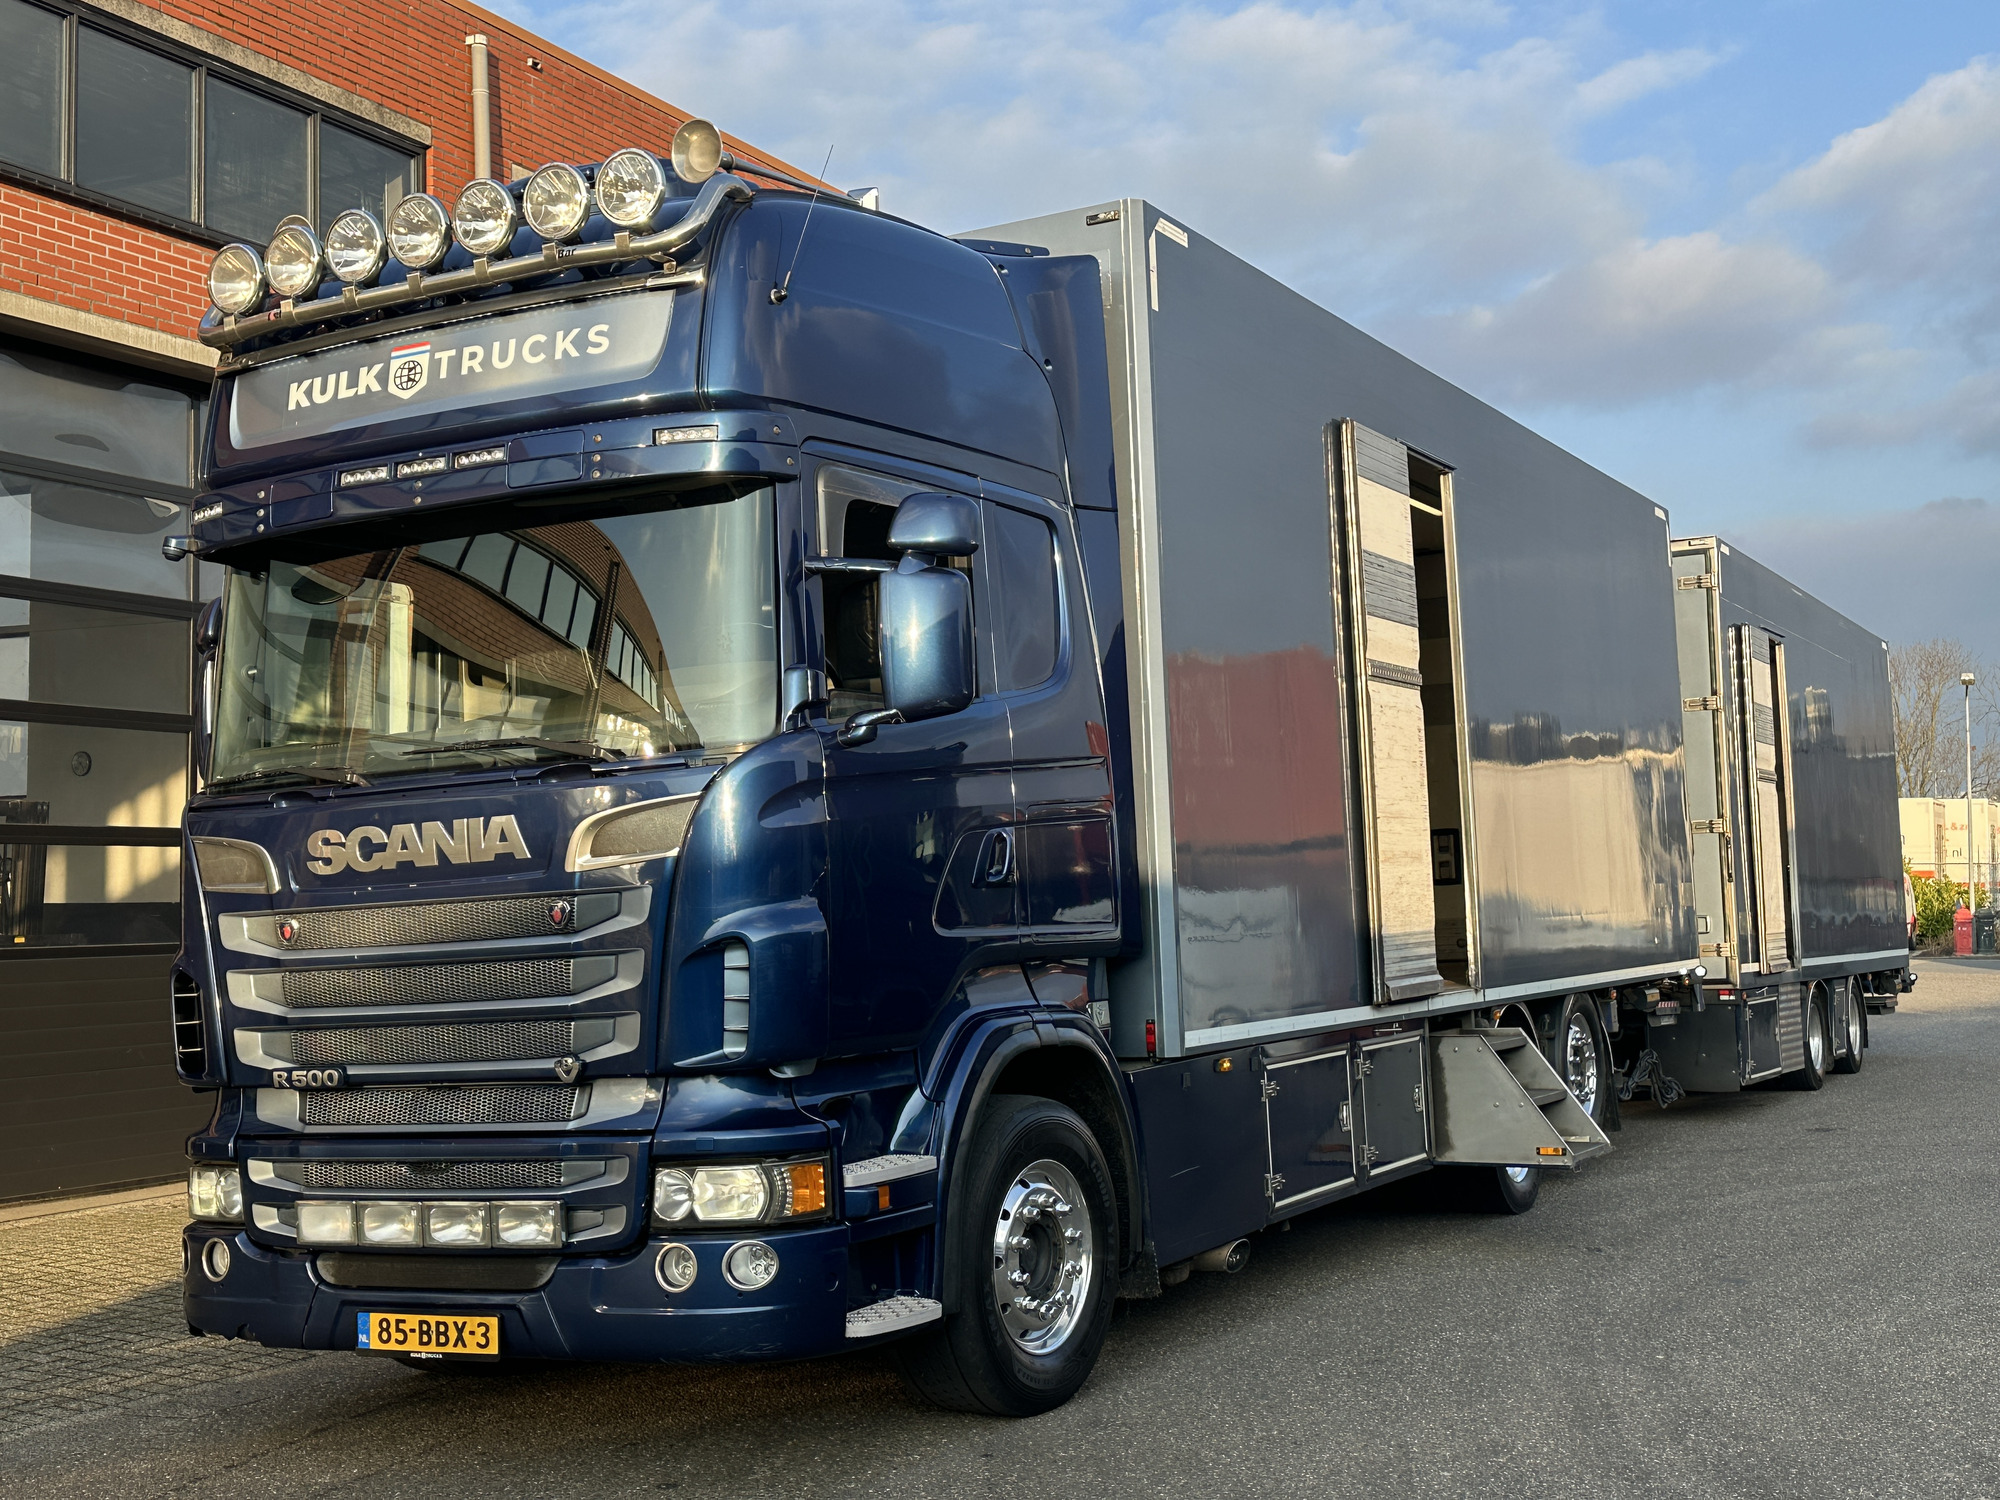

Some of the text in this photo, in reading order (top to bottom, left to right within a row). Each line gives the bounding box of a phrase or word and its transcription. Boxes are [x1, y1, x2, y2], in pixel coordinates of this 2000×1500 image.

[557, 247, 577, 259] Bar
[287, 323, 610, 411] KULK TRUCKS
[306, 814, 532, 876] SCANIA
[358, 1333, 370, 1343] NL
[377, 1317, 491, 1349] 85-BBX-3
